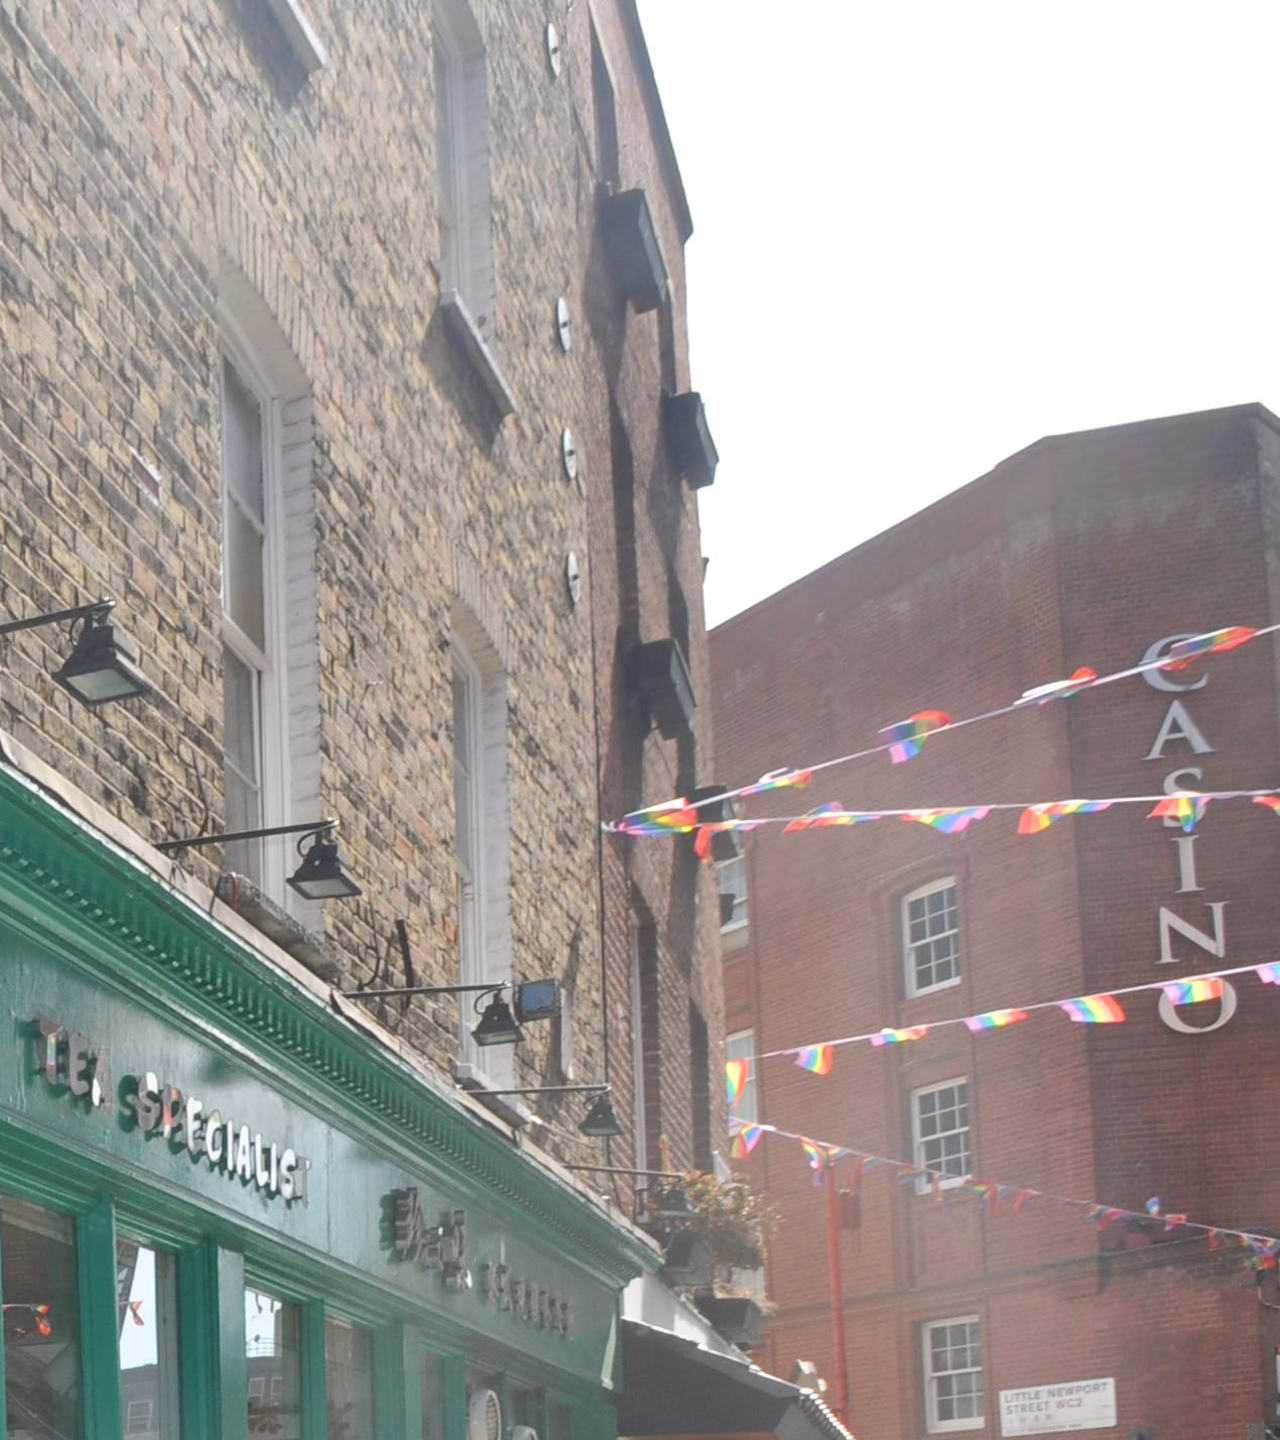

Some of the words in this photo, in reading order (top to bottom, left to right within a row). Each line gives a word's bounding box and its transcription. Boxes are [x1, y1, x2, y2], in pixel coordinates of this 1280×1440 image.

[137, 1071, 311, 1208] SPECIALIST
[1004, 1389, 1041, 1403] LITTLE
[1047, 1382, 1109, 1398] NEWPORT
[1005, 1401, 1051, 1415] STREET
[1055, 1398, 1083, 1409] WC2
